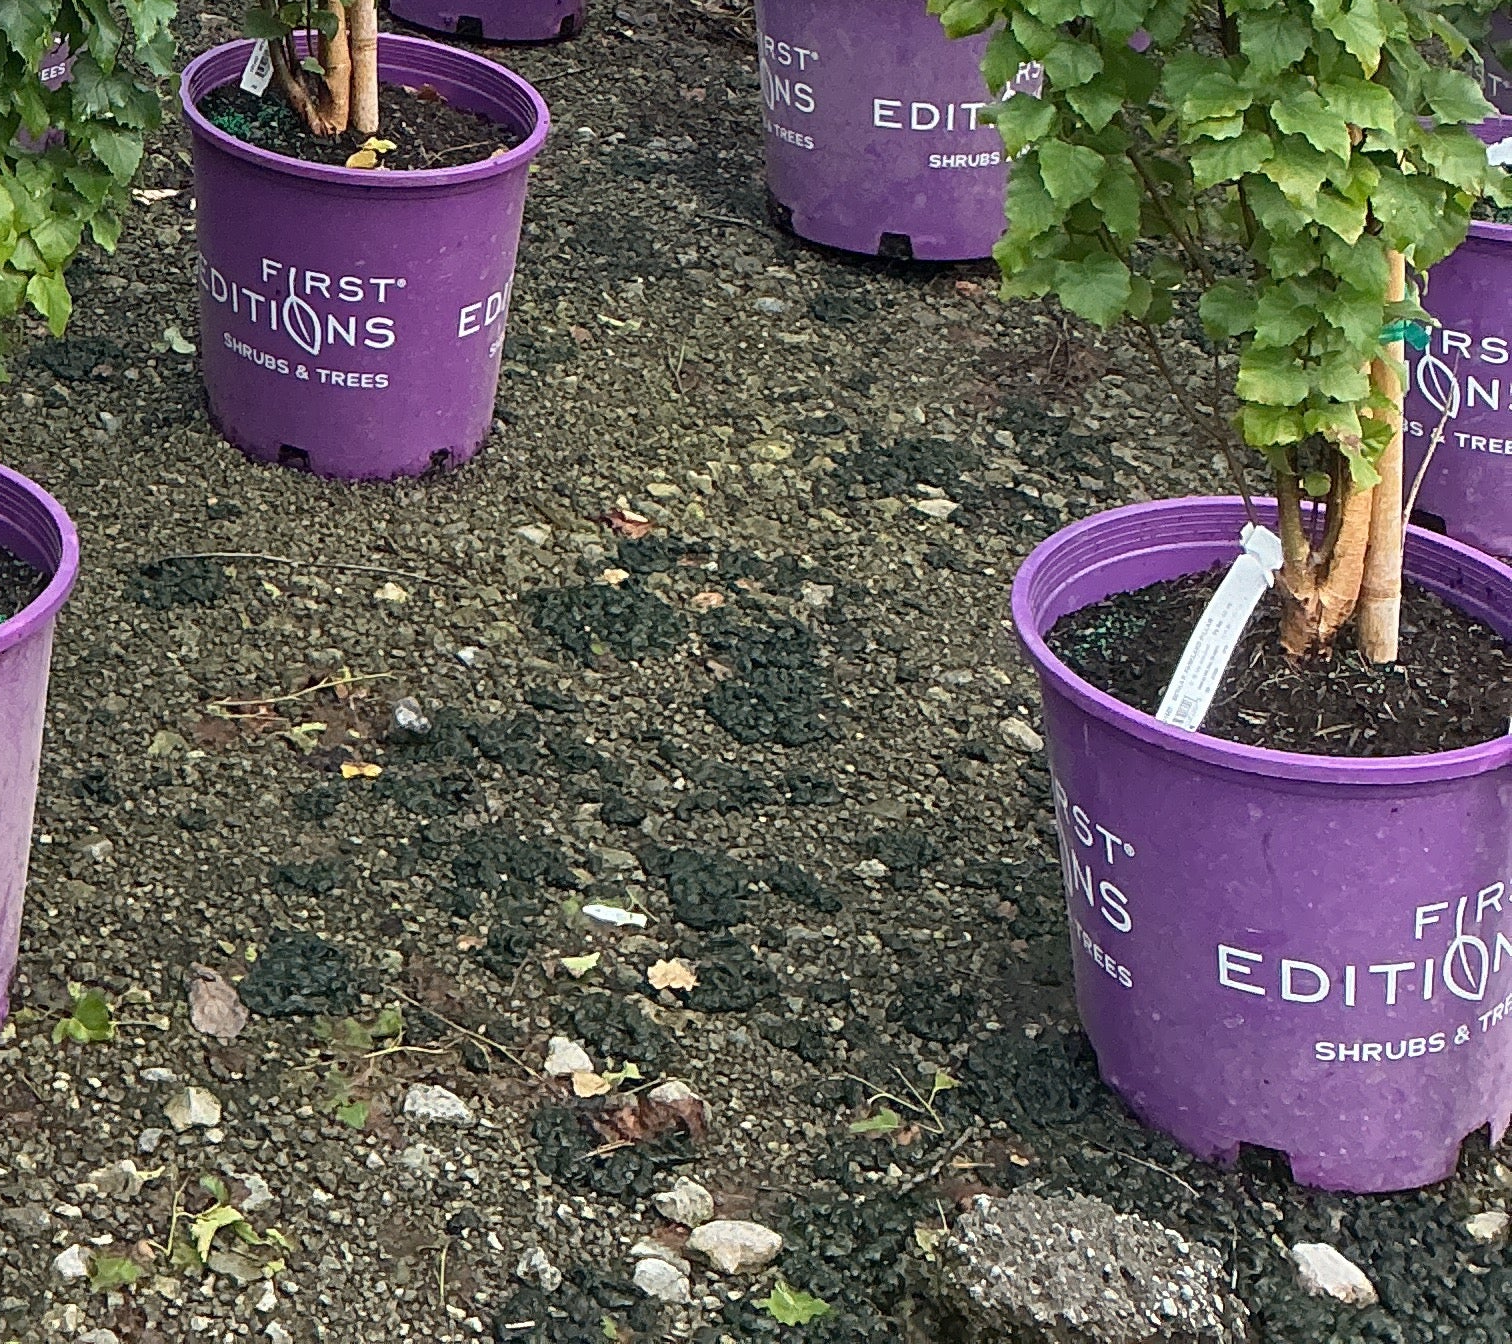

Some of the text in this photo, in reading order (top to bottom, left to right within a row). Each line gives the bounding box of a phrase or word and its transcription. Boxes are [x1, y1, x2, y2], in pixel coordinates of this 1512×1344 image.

[773, 124, 815, 150] TREES
[928, 152, 1000, 169] SHRUBS
[223, 332, 389, 389] SHRUBS & TREES
[1414, 879, 1512, 941] FIR
[1074, 918, 1133, 988] TREES
[1315, 1031, 1446, 1062] SHRUBS
[1454, 1024, 1471, 1045] &
